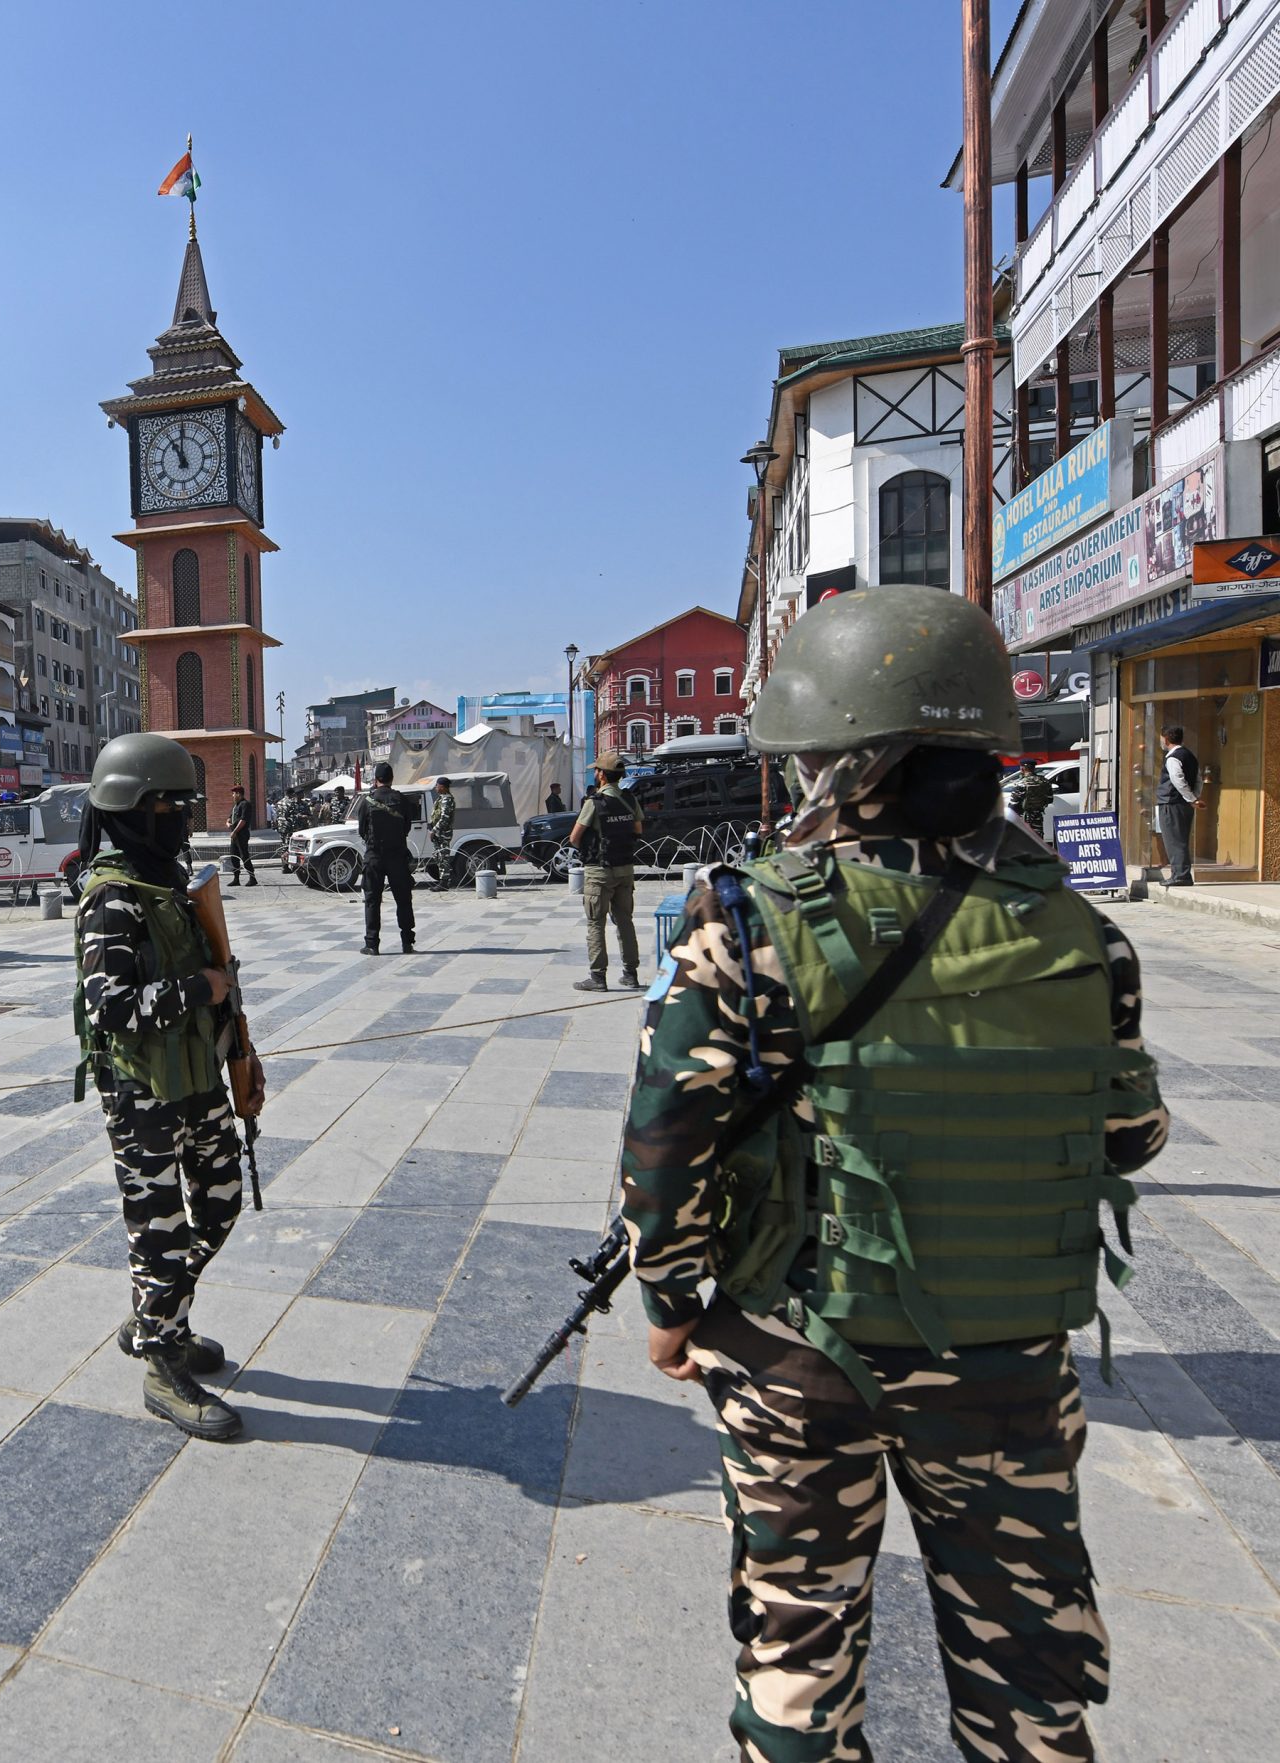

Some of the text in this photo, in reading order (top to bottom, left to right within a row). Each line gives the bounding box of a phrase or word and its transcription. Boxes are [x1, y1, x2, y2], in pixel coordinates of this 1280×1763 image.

[1006, 488, 1034, 526] HOTEL
[1036, 467, 1064, 508] LALA
[1067, 427, 1108, 479] RUKH
[1043, 498, 1058, 517] AND
[1022, 493, 1083, 548] RESTAURANT
[1022, 554, 1063, 595] KASHMIR
[1066, 506, 1142, 570] GOVERNMENT
[1231, 550, 1272, 571] Agfa
[1039, 584, 1061, 612] ARTS
[1063, 551, 1122, 603] EMPORIUM
[1058, 816, 1113, 827] JAMMU & KASHMIR
[1057, 826, 1117, 843] GOVERNMENT
[1078, 843, 1101, 857] ARTS
